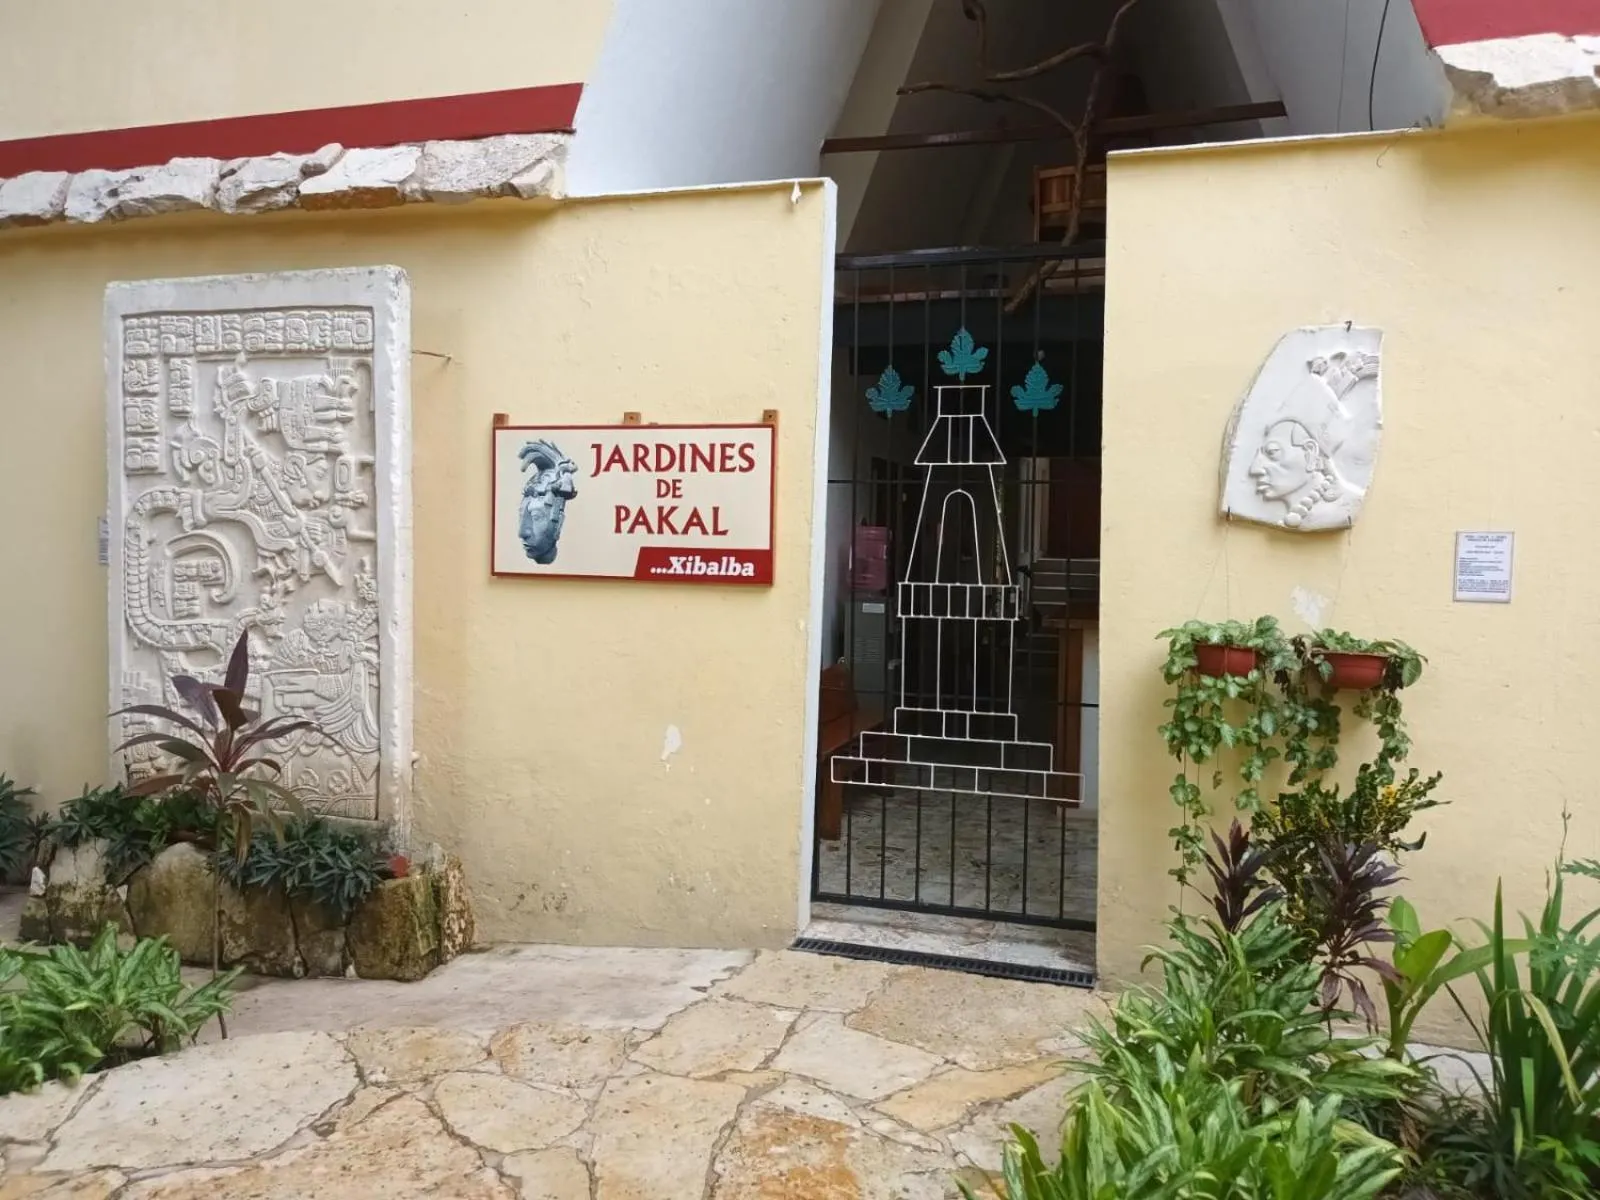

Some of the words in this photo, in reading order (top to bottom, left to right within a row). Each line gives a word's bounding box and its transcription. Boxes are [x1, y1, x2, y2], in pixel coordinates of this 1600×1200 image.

[590, 442, 756, 478] JARDINES
[656, 479, 683, 499] DE
[614, 505, 729, 536] PAKAL
[650, 556, 755, 577] ...Xibalba
